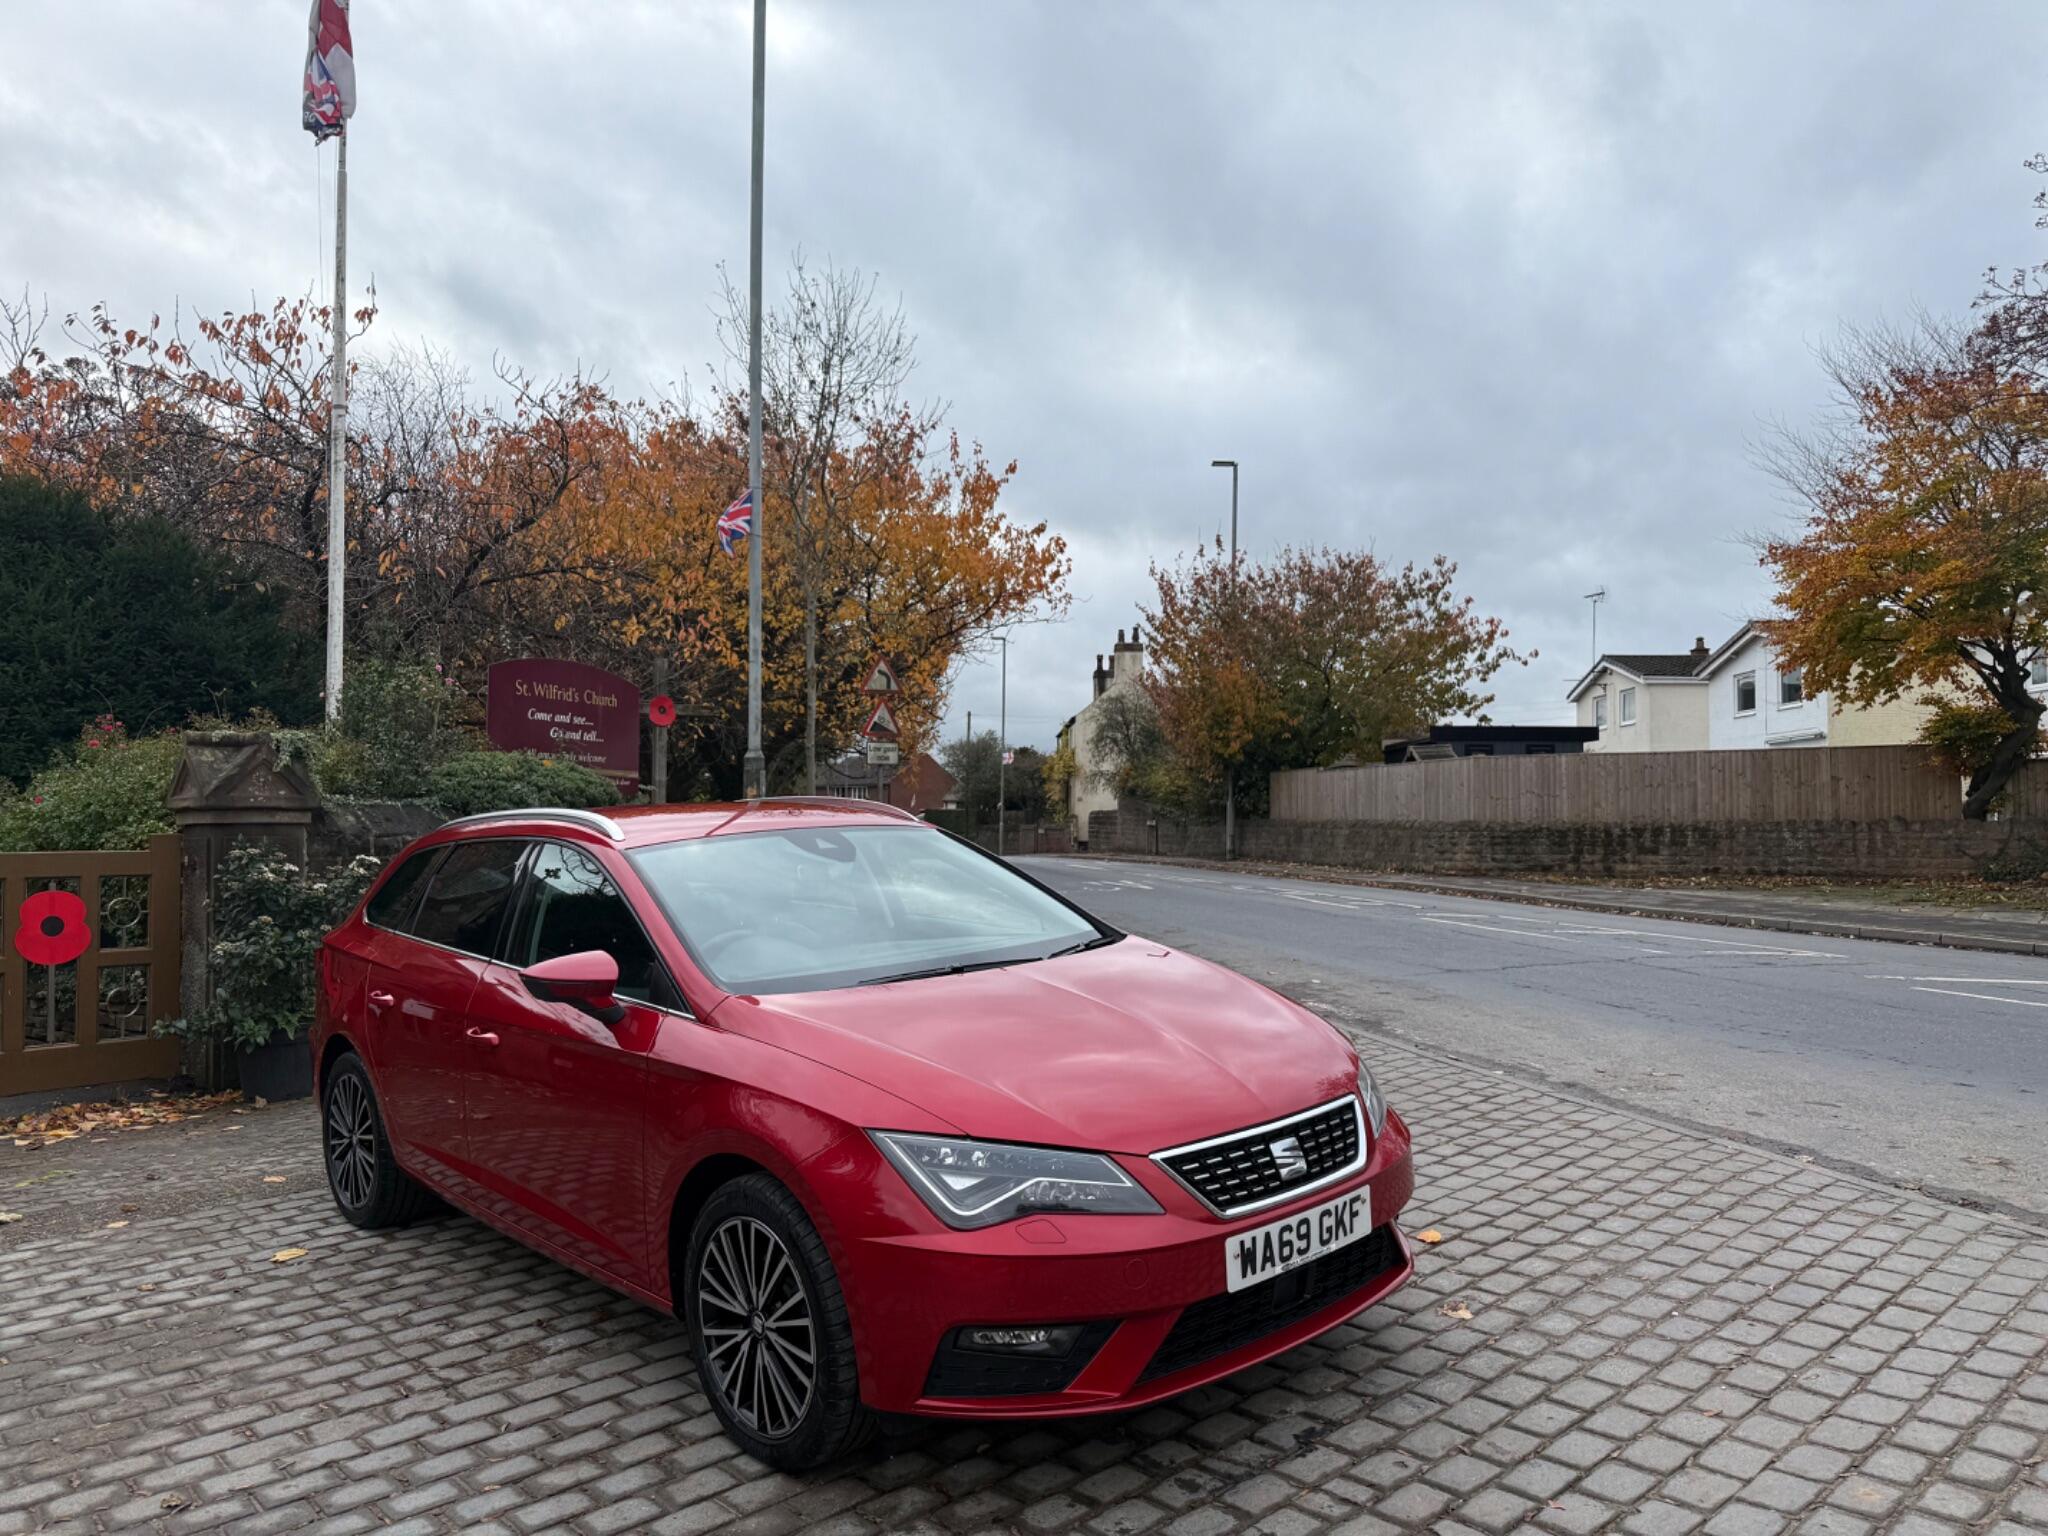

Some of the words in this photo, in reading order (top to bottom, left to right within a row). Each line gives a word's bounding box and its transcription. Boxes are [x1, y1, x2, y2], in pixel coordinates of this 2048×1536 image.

[515, 679, 531, 696] St.
[533, 681, 580, 703] Wilfrid's
[584, 689, 618, 708] Church
[527, 708, 553, 722] Come
[555, 712, 571, 724] and
[1239, 1217, 1311, 1280] WA69
[1318, 1194, 1362, 1247] GKF
